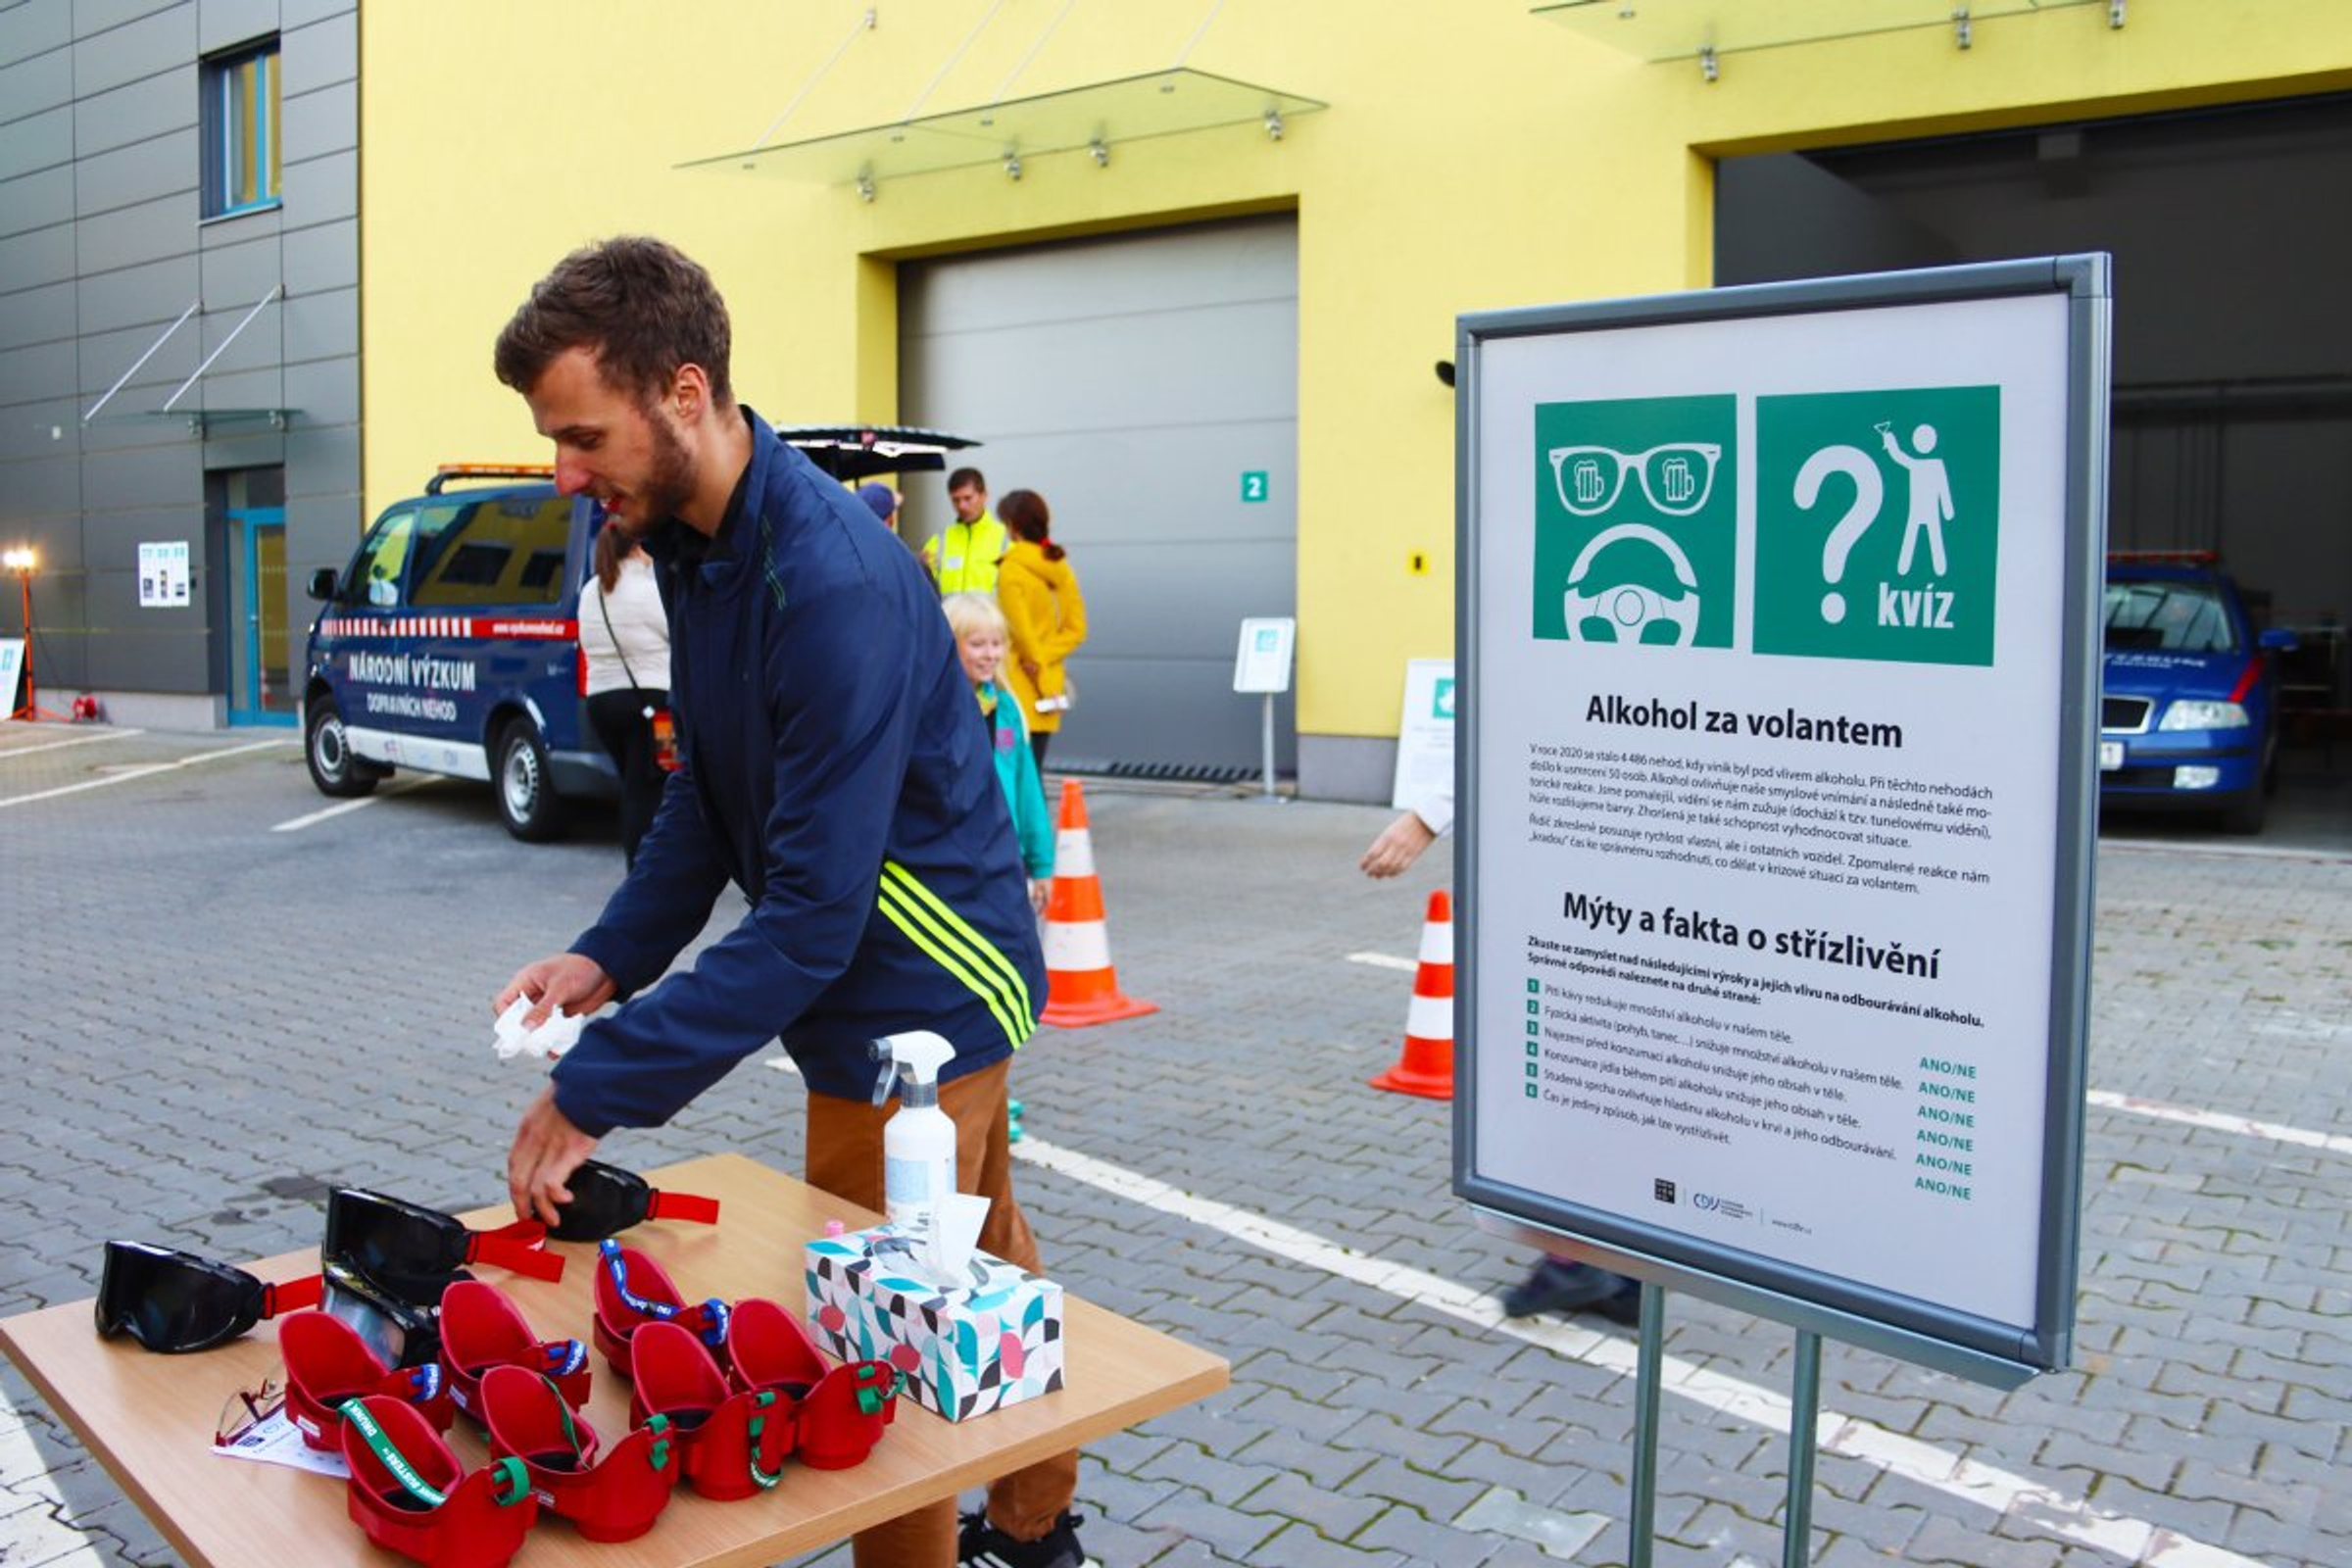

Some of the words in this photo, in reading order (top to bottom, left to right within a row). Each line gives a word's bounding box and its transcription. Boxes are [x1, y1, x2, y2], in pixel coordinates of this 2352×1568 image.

[1249, 476, 1261, 496] 2
[1878, 582, 1955, 628] kvíz
[349, 651, 410, 685] NÁRODNÍ
[412, 653, 476, 691] VÝZKUM
[1586, 695, 1697, 730] Alkohol
[1705, 707, 1739, 734] za
[1747, 708, 1903, 748] volantem
[1559, 746, 1583, 759] 2020
[1629, 753, 1647, 764] 486
[1686, 759, 1705, 773] kdy
[1707, 760, 1732, 773] viník
[1733, 762, 1750, 777] byl
[1751, 766, 1774, 779] pod
[1776, 767, 1812, 781] vlivem
[1870, 776, 1885, 788] Při
[1887, 777, 1927, 792] těchto
[1929, 783, 1992, 799] nehodách
[1609, 768, 1620, 779] 50
[1649, 772, 1690, 787] Alkohol
[1740, 783, 1767, 795] naše
[1768, 787, 1819, 801] smyslové
[1821, 792, 1869, 806] vnímání
[1936, 802, 1964, 816] také
[1966, 808, 1991, 818] mo-
[1638, 806, 1685, 820] Zhoršená
[1686, 810, 1696, 824] je
[1699, 812, 1721, 825] také
[1723, 816, 1780, 832] schopnost
[1782, 823, 1863, 842] vyhodnocovat
[1866, 832, 1912, 848] situace.
[1711, 799, 1723, 808] se
[1725, 799, 1749, 810] nám
[1752, 802, 1788, 817] zužuje
[1789, 805, 1838, 820] (dochází
[1848, 810, 1869, 824] tzv.
[1871, 813, 1943, 832] tunelovému
[1587, 838, 1598, 849] ke
[1715, 858, 1728, 866] co
[1768, 861, 1806, 877] krizové
[1809, 868, 1844, 883] situaci
[1846, 875, 1859, 885] za
[1862, 876, 1919, 893] volantem.
[1644, 830, 1684, 843] rychlost
[1725, 839, 1740, 851] ale
[1749, 843, 1799, 858] ostatních
[1803, 851, 1844, 864] vozidel.
[1848, 854, 1915, 873] Zpomalené
[1918, 865, 1958, 879] reakce
[1961, 869, 1990, 882] nám
[1563, 892, 1632, 934] Mýty
[1640, 909, 1655, 933] a
[1663, 906, 1740, 947] fakta
[1747, 929, 1766, 951] o
[1775, 929, 1941, 980] střízlivění
[1562, 943, 1572, 953] se
[1619, 953, 1639, 964] nad
[1641, 956, 1710, 977] následujícími
[1712, 968, 1750, 988] výroky
[1760, 975, 1791, 992] jejich
[1794, 983, 1823, 998] vlivu
[1825, 990, 1839, 1001] na
[1841, 992, 1921, 1015] odbourávání
[1618, 969, 1669, 987] naleznete
[1672, 980, 1685, 990] na
[1688, 980, 1720, 997] druhé
[1722, 987, 1762, 1004] straně:
[1629, 1002, 1676, 1018] množství
[1676, 1009, 1721, 1027] alkoholu
[1733, 1022, 1767, 1036] našem
[1769, 1027, 1793, 1042] těle.
[1665, 1053, 1710, 1071] alkoholu
[1712, 1064, 1749, 1082] snižuje
[1750, 1069, 1776, 1085] jeho
[1777, 1077, 1811, 1093] obsah
[1823, 1085, 1848, 1102] těle.
[1695, 1038, 1731, 1055] snižuje
[1732, 1047, 1781, 1064] množství
[1782, 1055, 1829, 1074] alkoholu
[1840, 1069, 1877, 1084] našem
[1880, 1074, 1903, 1090] těle.
[1919, 1056, 1977, 1079] ANO/NE
[1544, 1047, 1598, 1068] Konzumace
[1678, 1077, 1723, 1096] alkoholu
[1725, 1089, 1762, 1107] snižuje
[1763, 1096, 1788, 1111] jeho
[1791, 1103, 1825, 1119] obsah
[1837, 1111, 1862, 1128] těle.
[1918, 1081, 1975, 1103] ANO/NE
[1560, 1093, 1570, 1107] je
[1641, 1112, 1656, 1126] jak
[1658, 1116, 1673, 1130] lze
[1705, 1106, 1750, 1125] alkoholu
[1761, 1118, 1783, 1133] krvi
[1791, 1125, 1818, 1141] jeho
[1821, 1133, 1896, 1159] odbourávání.
[1917, 1104, 1975, 1128] ANO/NE
[1916, 1129, 1973, 1152] ANO/NE
[1915, 1153, 1972, 1176] ANO/NE
[1914, 1176, 1971, 1200] ANO/NE
